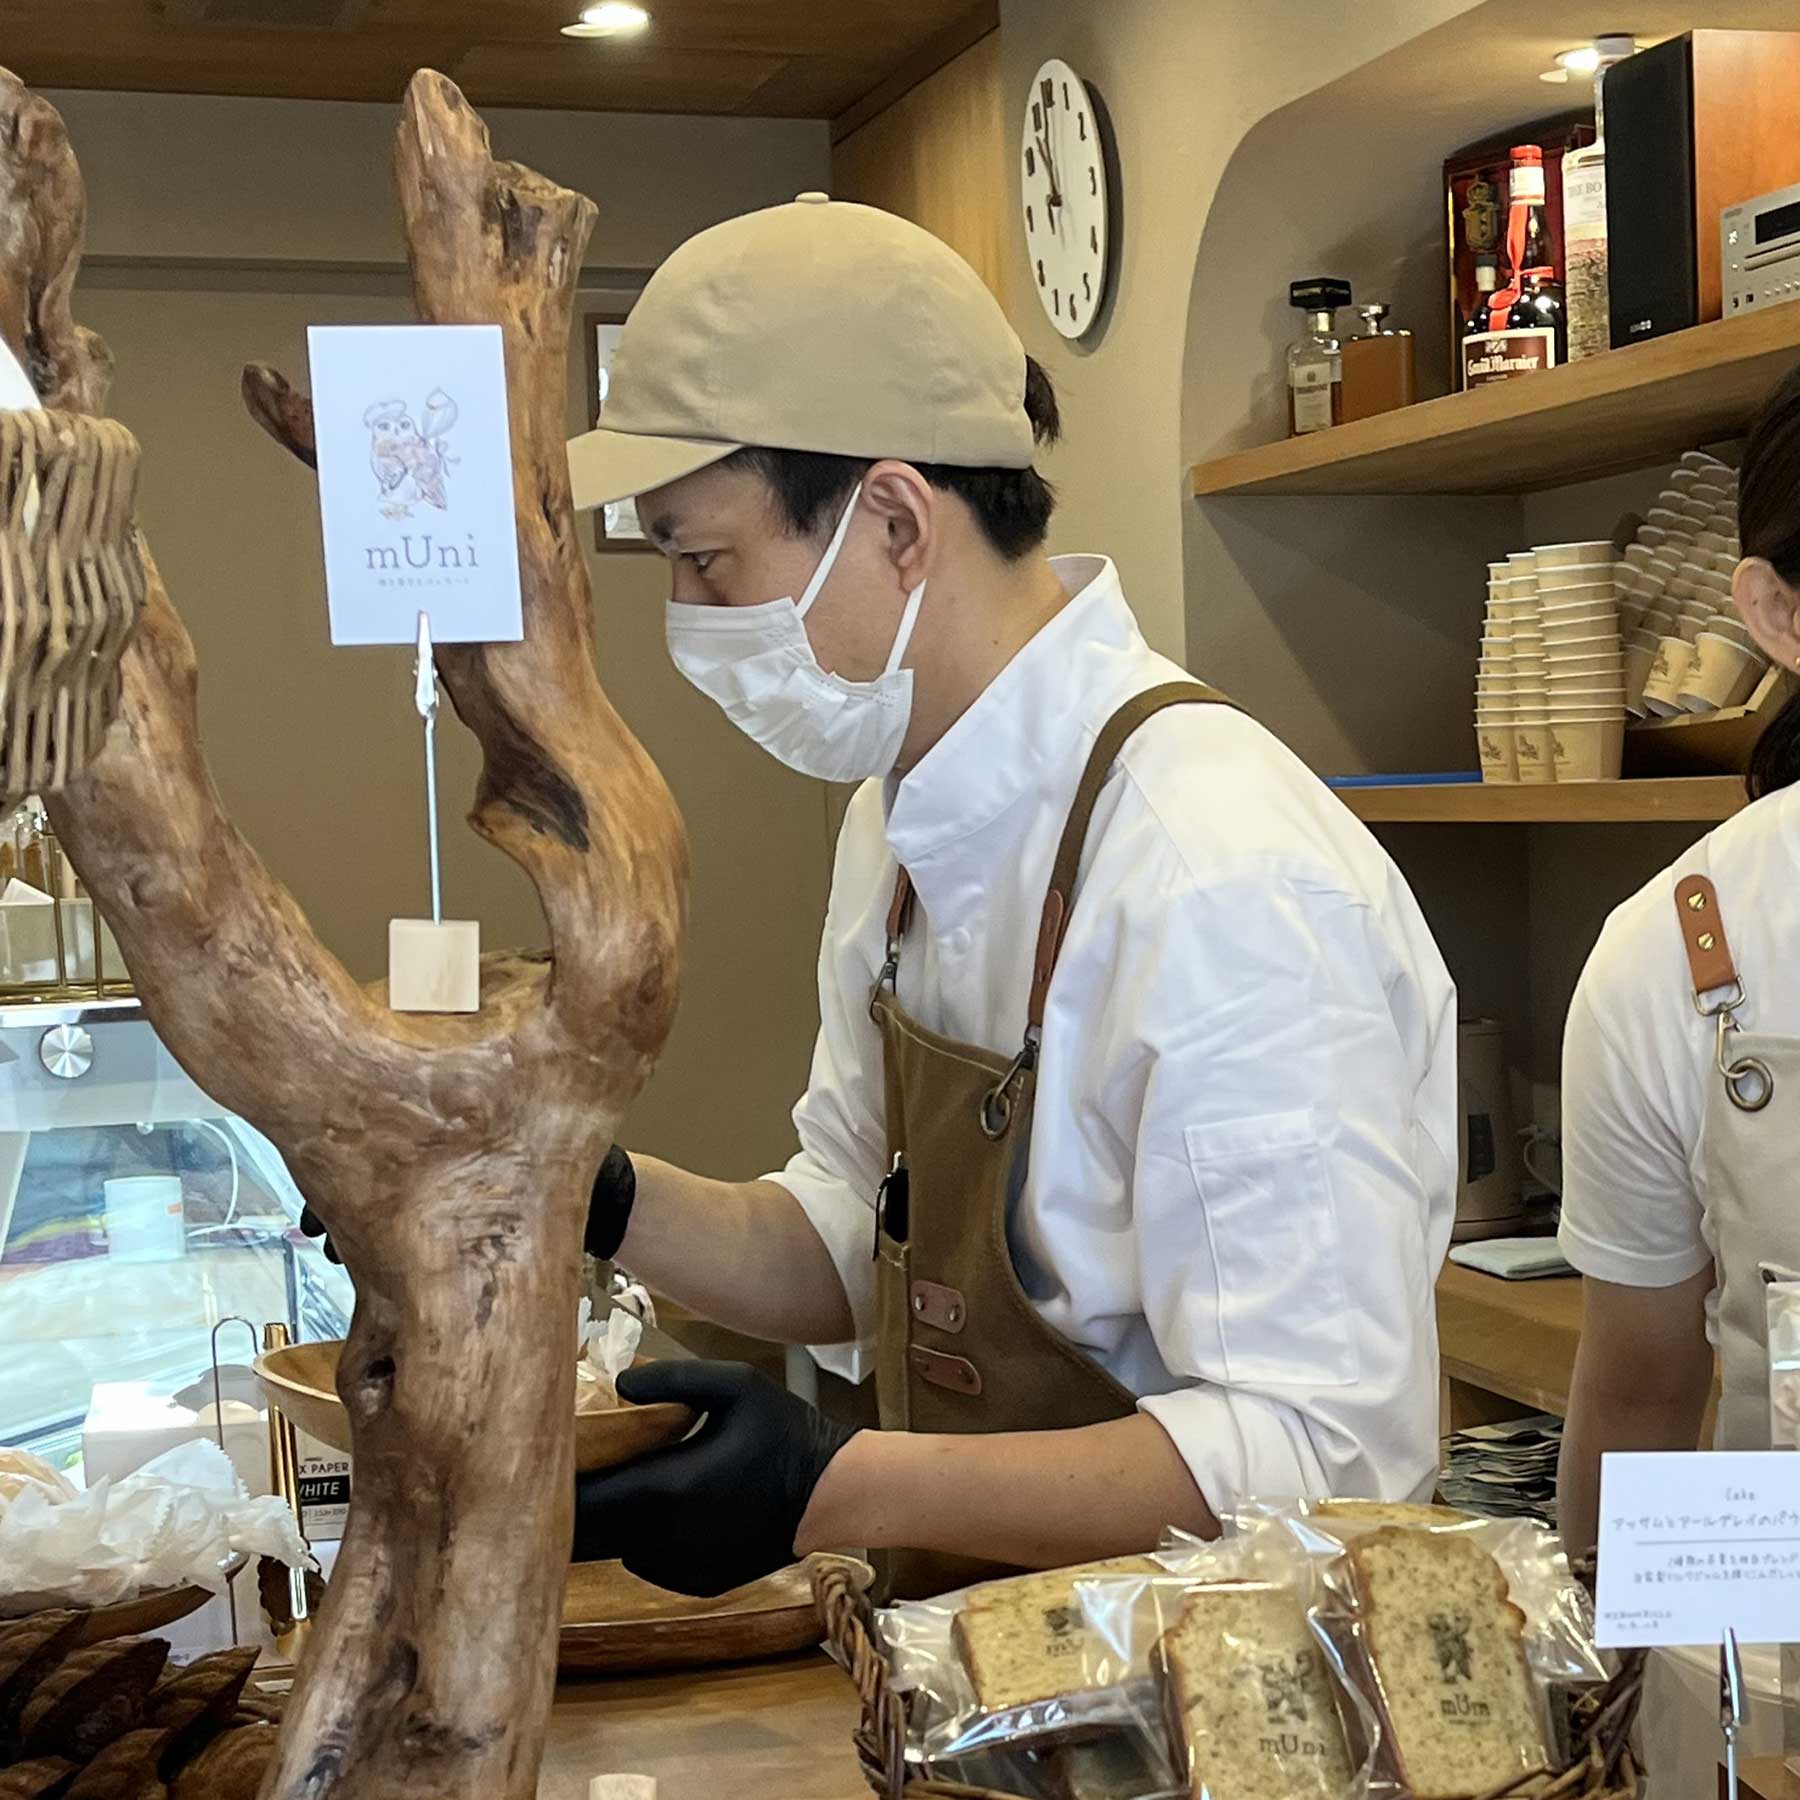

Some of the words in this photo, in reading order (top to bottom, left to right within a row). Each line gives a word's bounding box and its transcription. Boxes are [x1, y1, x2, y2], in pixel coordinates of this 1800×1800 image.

[1063, 82, 1070, 110] 1
[1077, 112, 1087, 140] 2
[1088, 166, 1096, 195] 3
[1083, 272, 1090, 301] 5
[1052, 288, 1059, 315] 7
[1069, 293, 1077, 321] 6
[364, 534, 478, 568] mUni
[311, 1462, 349, 1473] PAPER
[1259, 1734, 1326, 1756] mUni
